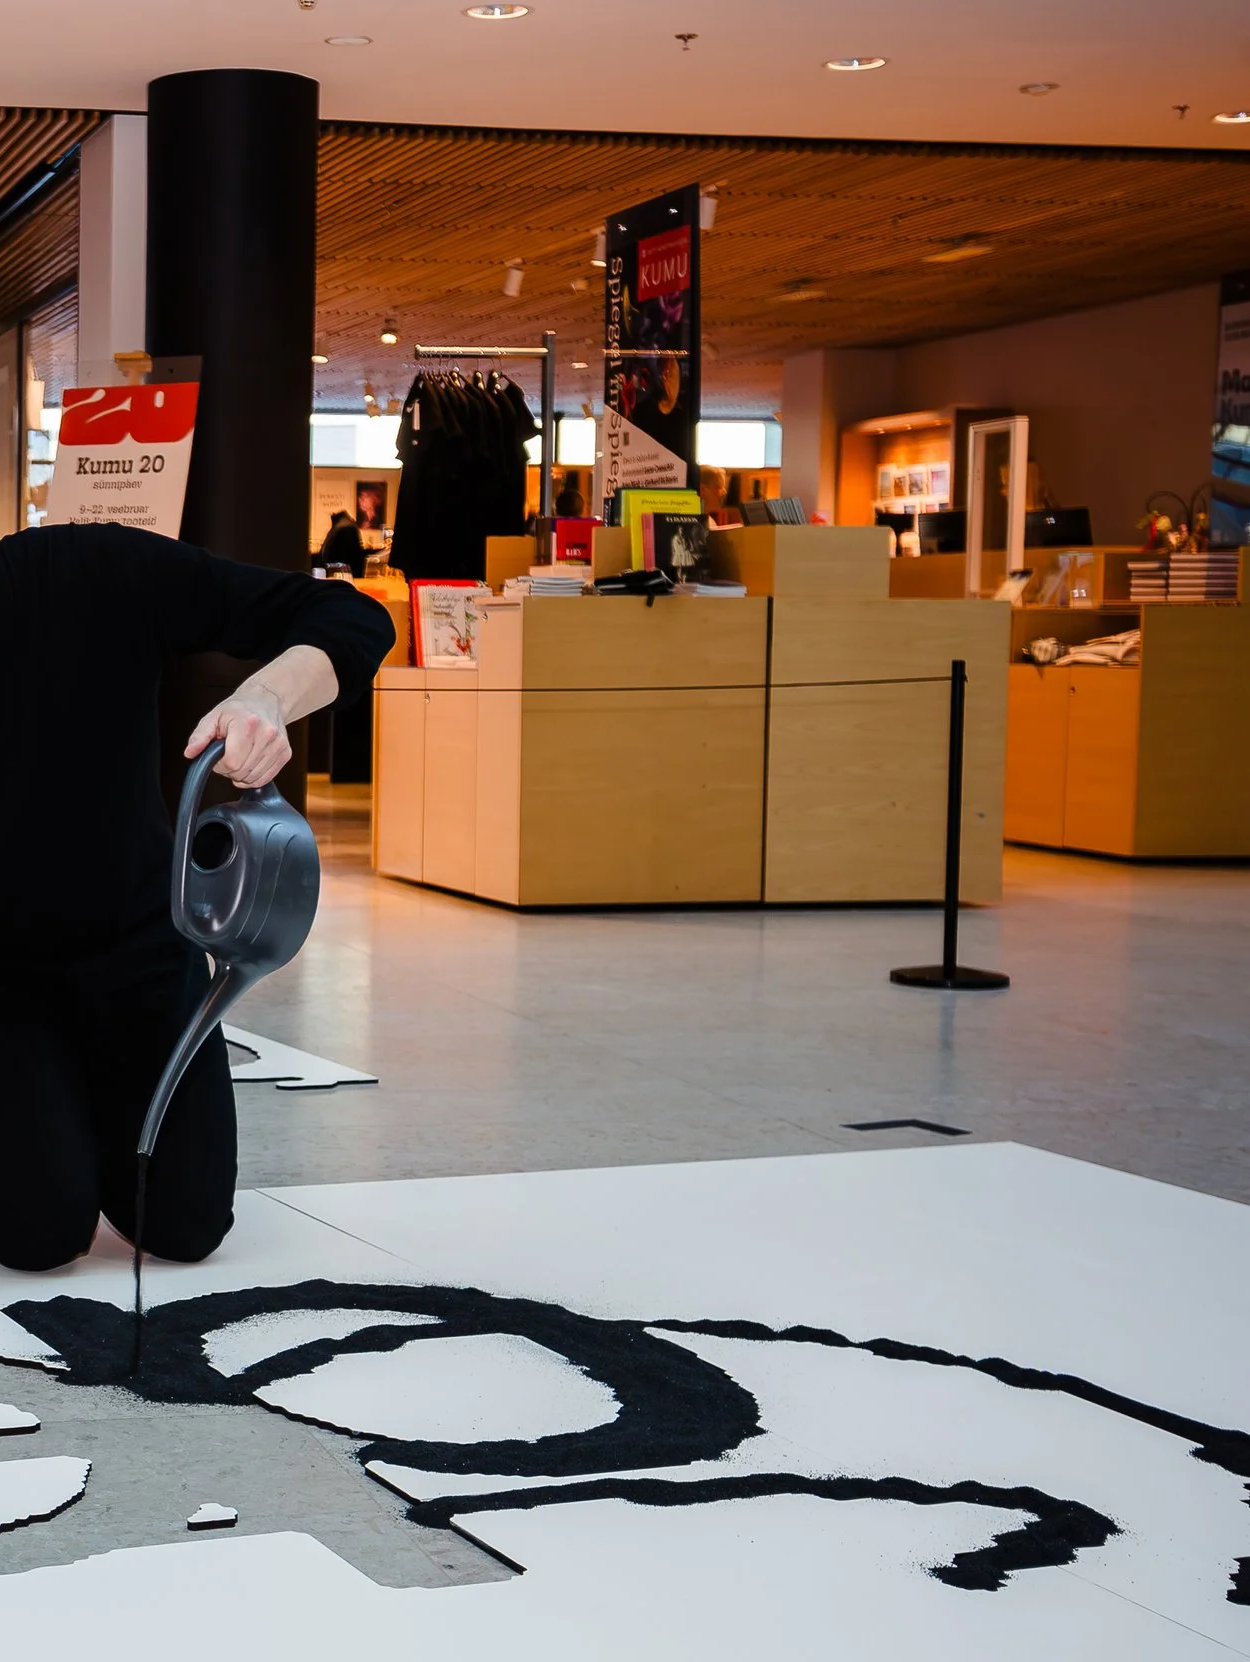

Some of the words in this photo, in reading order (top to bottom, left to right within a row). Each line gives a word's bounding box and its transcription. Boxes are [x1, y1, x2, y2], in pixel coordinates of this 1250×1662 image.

[640, 252, 688, 289] KUMU
[607, 256, 623, 368] Spiegel
[76, 456, 134, 475] Kumu
[139, 454, 165, 474] 20
[606, 413, 623, 496] Spieg
[107, 504, 150, 514] veebruar
